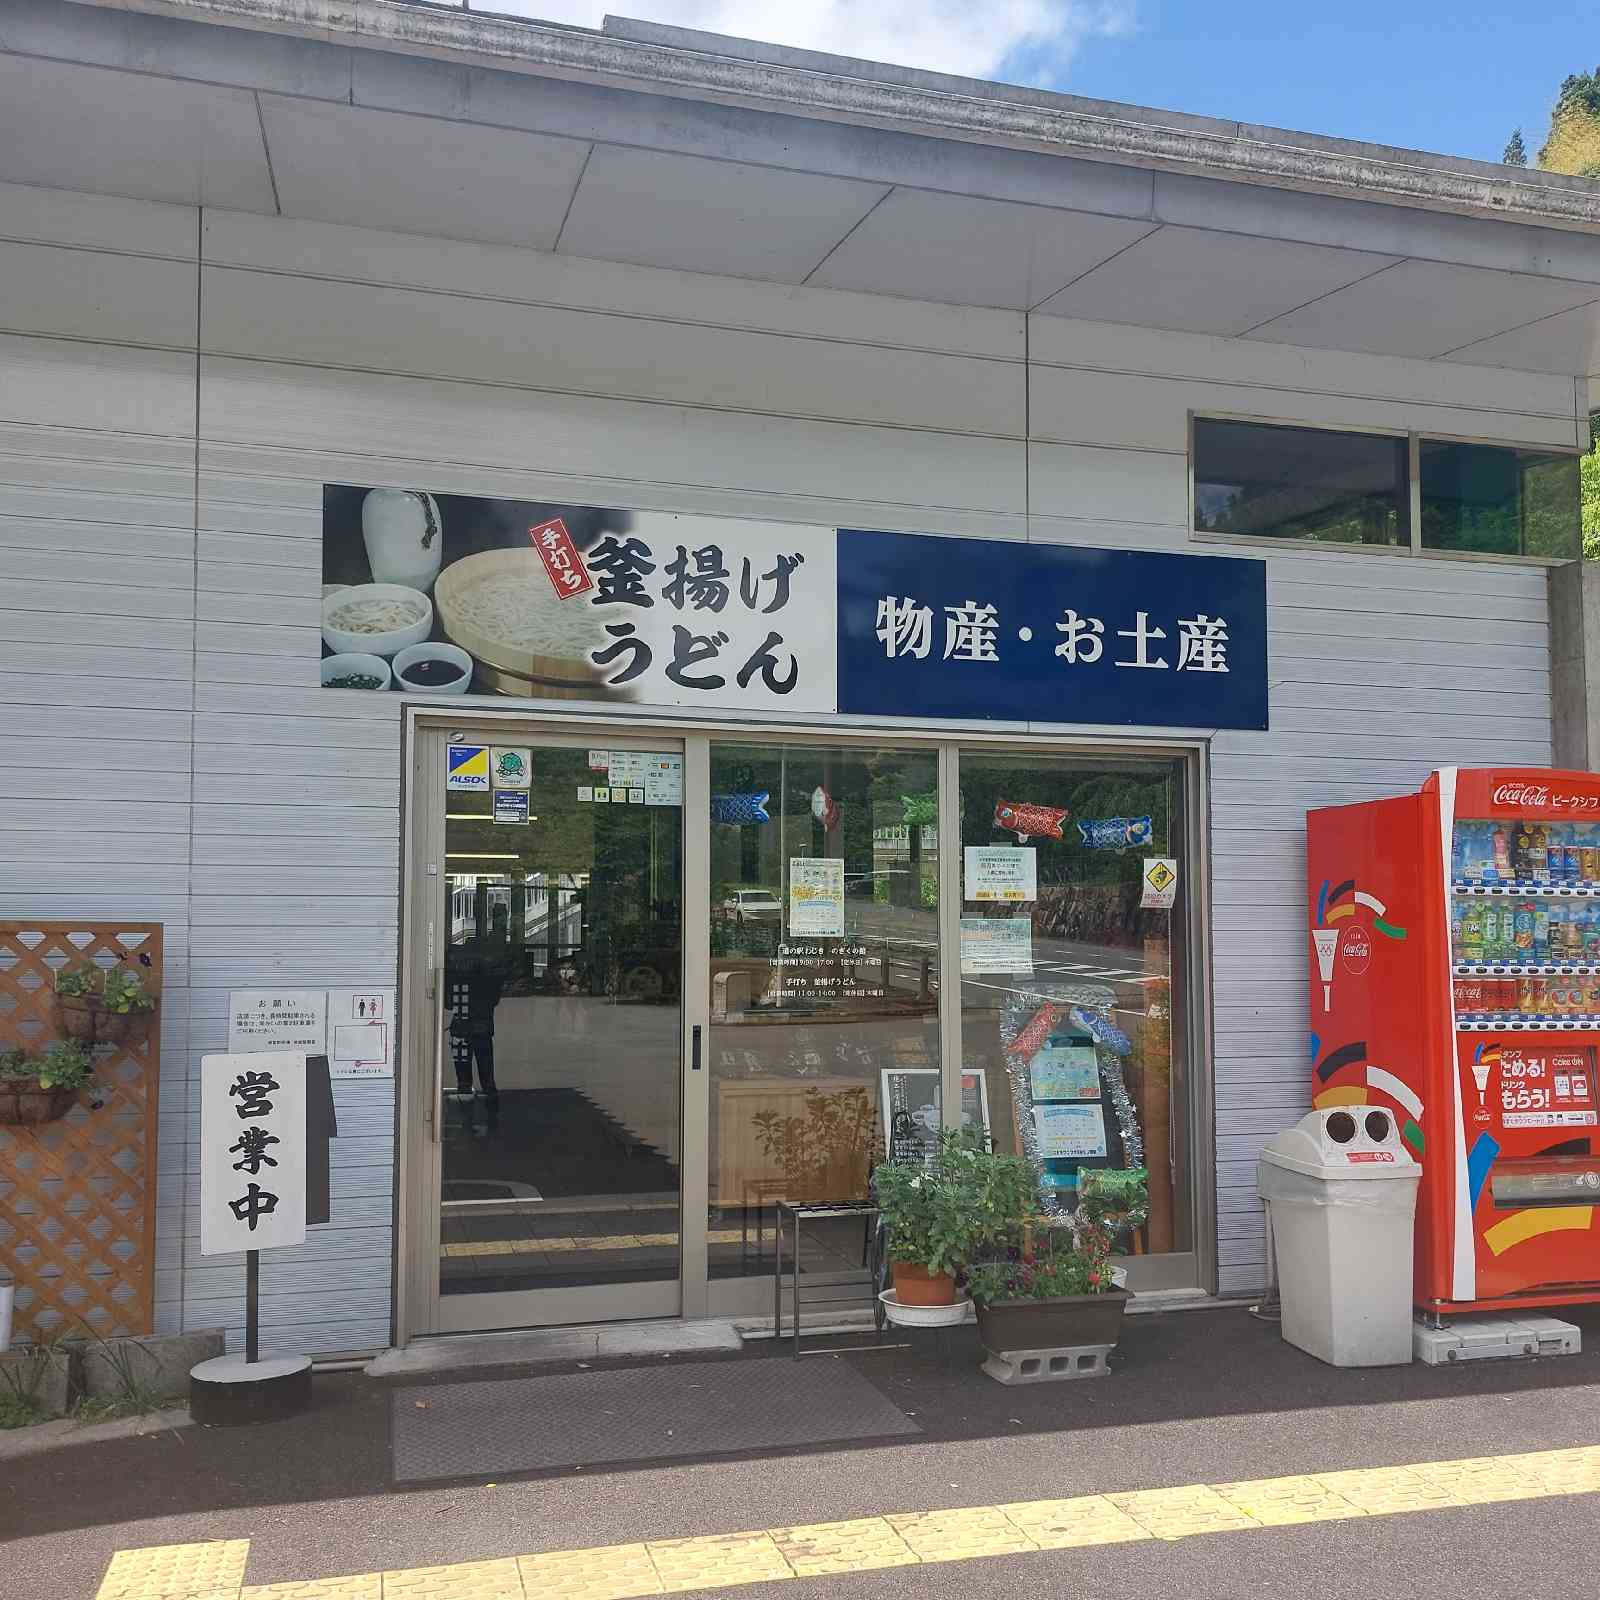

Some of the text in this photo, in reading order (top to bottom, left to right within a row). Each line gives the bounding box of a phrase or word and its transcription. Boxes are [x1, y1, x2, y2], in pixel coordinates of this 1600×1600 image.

[541, 527, 582, 590] 手打ち
[586, 535, 805, 615] 釜揚げ
[875, 594, 1230, 673] 物産・お土産
[590, 622, 799, 695] うどん
[449, 775, 488, 784] ALSOK
[1493, 784, 1552, 806] Coca-Cola
[258, 999, 296, 1008] お願い
[1501, 1080, 1526, 1089] ドリンク
[1501, 1088, 1551, 1110] もらう!
[228, 1070, 281, 1232] 営業中
